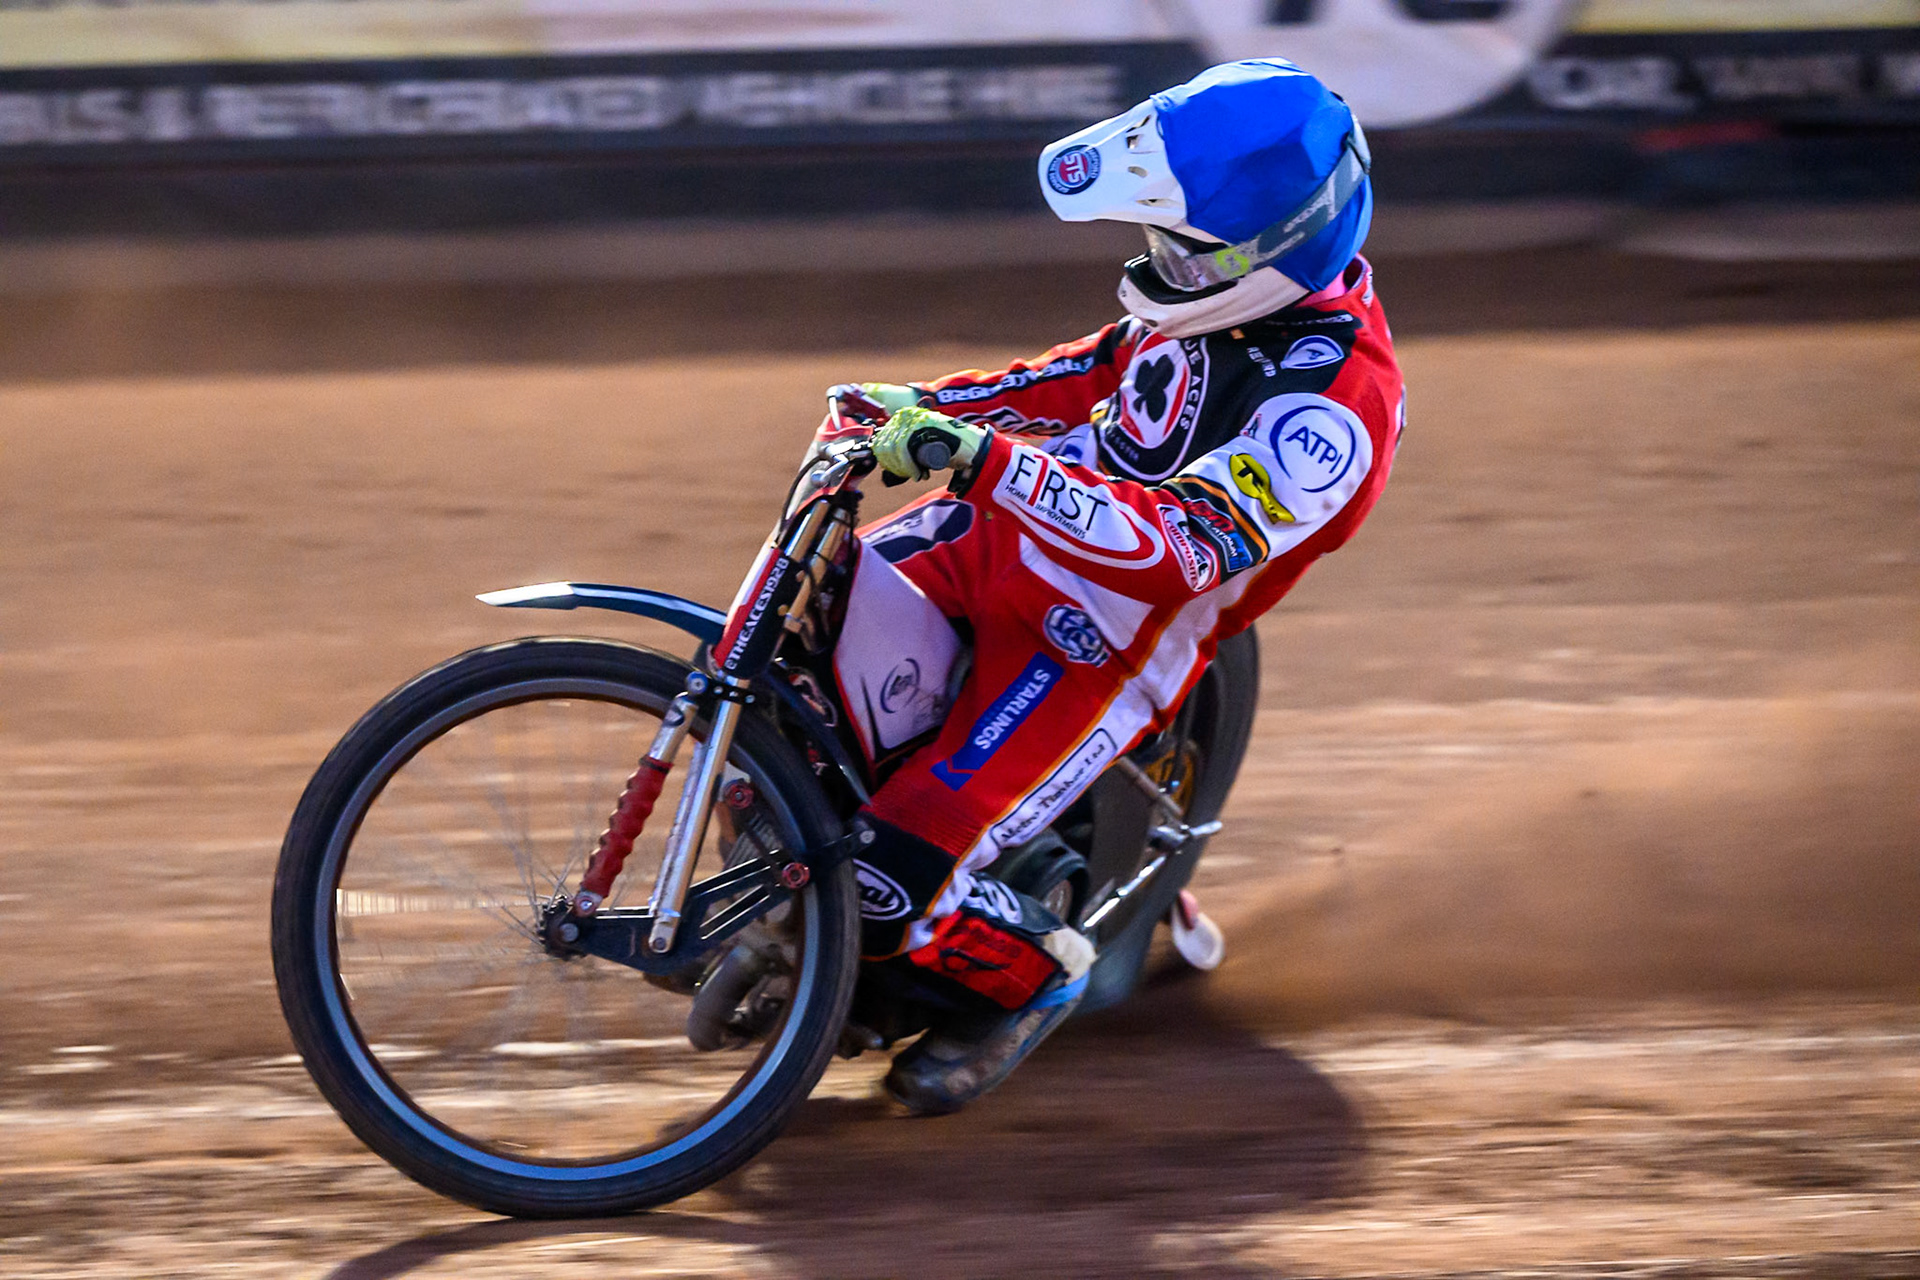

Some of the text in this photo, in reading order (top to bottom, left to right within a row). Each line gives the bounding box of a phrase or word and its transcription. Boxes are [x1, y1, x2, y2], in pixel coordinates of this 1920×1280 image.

[1179, 374, 1204, 431] ACES
[1284, 425, 1343, 474] ATPI
[1005, 484, 1087, 540] HOME IMPROVEMENTS
[724, 558, 789, 670] @THEACES1928
[973, 668, 1051, 750] STARLINGS
